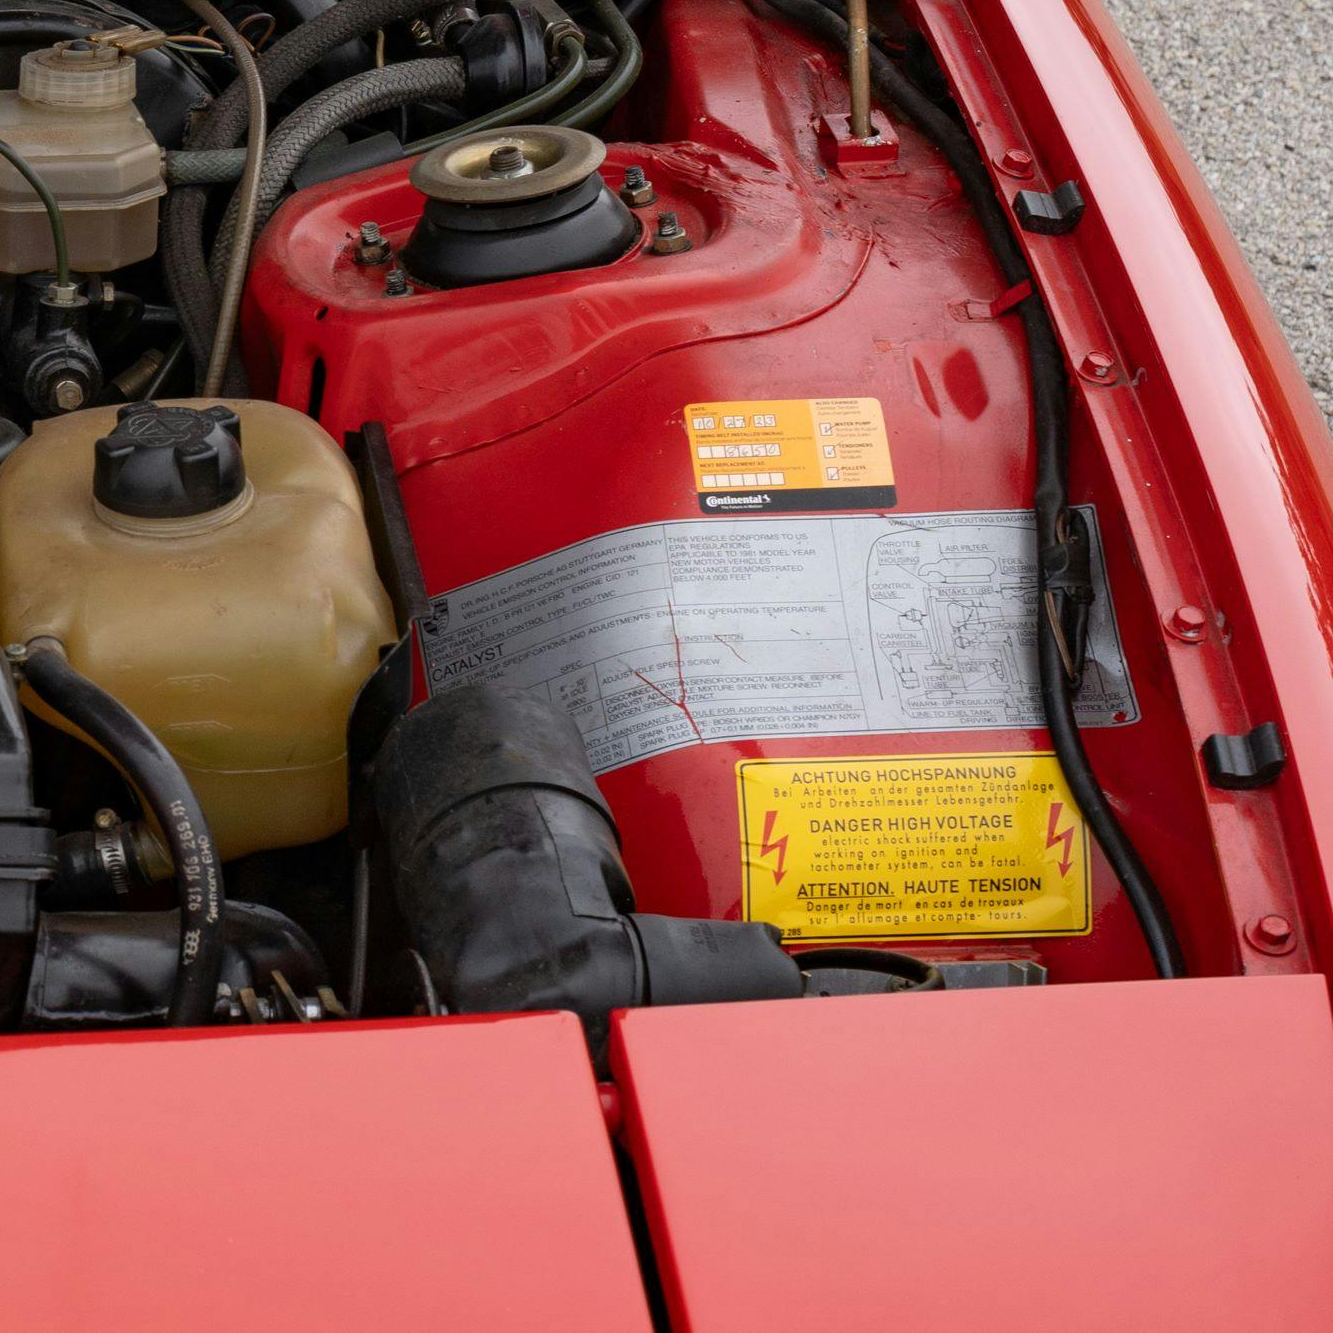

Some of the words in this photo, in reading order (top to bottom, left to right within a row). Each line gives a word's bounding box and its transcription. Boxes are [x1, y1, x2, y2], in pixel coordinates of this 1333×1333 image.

[706, 495, 762, 508] Continental
[667, 535, 689, 543] THIS
[690, 534, 727, 543] VEHICLE
[729, 533, 780, 542] CONFORMS
[668, 544, 686, 552] EPA
[690, 542, 751, 551] REGULATIONS
[670, 551, 723, 559] APPLICABLE
[725, 550, 737, 558] TO
[739, 550, 757, 558] 1981
[760, 549, 791, 557] MODEL
[792, 548, 816, 556] YEAR
[961, 544, 989, 552] FILTER
[516, 570, 554, 589] PORSCHE
[568, 547, 617, 568] STUTTGART
[618, 539, 663, 555] GERMANY
[671, 559, 691, 567] NEW
[693, 558, 726, 566] MOTOR
[728, 557, 771, 565] VEHICLES
[672, 567, 729, 575] COMPLIANCE
[733, 565, 803, 574] DEMONSTRATED
[572, 577, 604, 594] ENGINE
[605, 572, 621, 583] CID
[673, 575, 707, 583] BELOW
[730, 573, 752, 581] FEET
[463, 603, 496, 620] VEHICLE
[497, 587, 537, 606] EMISSION
[539, 572, 577, 592] CONTROL
[578, 554, 636, 578] INFORMATION
[939, 588, 968, 596] INTAKE
[456, 621, 484, 638] FAMILY
[506, 617, 544, 636] CONTROL
[569, 631, 585, 643] AND
[692, 608, 705, 616] ON
[709, 606, 759, 616] OPERATING
[761, 605, 827, 614] TEMPERATURE
[684, 634, 744, 642] INSTRUCTION
[433, 642, 504, 682] CATALYST
[560, 660, 583, 674] SPEC
[686, 658, 721, 666] SCREW
[691, 677, 730, 686] SENSOR
[810, 673, 845, 681] BEFORE
[697, 684, 735, 693] MIXTURE
[771, 681, 822, 690] RECONNECT
[608, 708, 642, 722] OXYGEN
[612, 715, 671, 737] MAINTENANCE
[717, 706, 735, 715] FOR
[738, 705, 791, 713] ADDITIONAL
[792, 702, 853, 712] INFORMATION
[637, 730, 665, 742] SPARK
[665, 724, 689, 735] PLUG
[713, 717, 743, 726] BOSCH
[777, 714, 789, 722] OR
[789, 712, 838, 722] CHAMPION
[639, 737, 667, 750] SPARK
[667, 730, 691, 742] PLUG
[791, 770, 871, 785] ACHTUNG
[877, 766, 1017, 782] HOCHSPANNUNG
[773, 787, 793, 798] Bei
[803, 785, 857, 797] Arbeiten
[870, 786, 884, 795] an
[889, 783, 908, 795] der
[916, 783, 974, 796] gesamten
[981, 780, 1055, 795] Zündanlage
[800, 798, 821, 809] und
[829, 796, 929, 809] Drehzahlmesser
[936, 794, 1023, 808] Lebensgefahr.
[810, 818, 883, 833] DANGER
[888, 816, 931, 831] HIGH
[936, 814, 1013, 830] VOLTAGE
[821, 834, 870, 846] electric
[876, 833, 911, 845] shock
[916, 832, 967, 844] suffered
[974, 832, 1005, 843] when
[813, 848, 864, 861] working
[871, 849, 886, 858] on
[895, 847, 946, 860] ignition
[955, 846, 979, 856] and
[810, 861, 880, 872] tachometer
[887, 860, 933, 872] system,
[941, 858, 963, 869] can
[969, 857, 984, 868] be
[990, 855, 1025, 867] fatal.
[796, 881, 895, 898] ATTENTION.
[904, 879, 960, 895] HAUTE
[968, 876, 1042, 893] TENSION
[187, 886, 203, 912] 931
[806, 900, 851, 913] Danger
[856, 899, 872, 911] de
[875, 899, 903, 910] mort
[915, 900, 930, 910] en
[933, 899, 953, 909] cas
[960, 897, 975, 909] de
[977, 896, 1025, 908] travaux
[809, 915, 829, 925] sur
[848, 912, 908, 926] allumage
[915, 913, 927, 922] et
[989, 909, 1027, 922] tours.
[786, 927, 802, 937] 285
